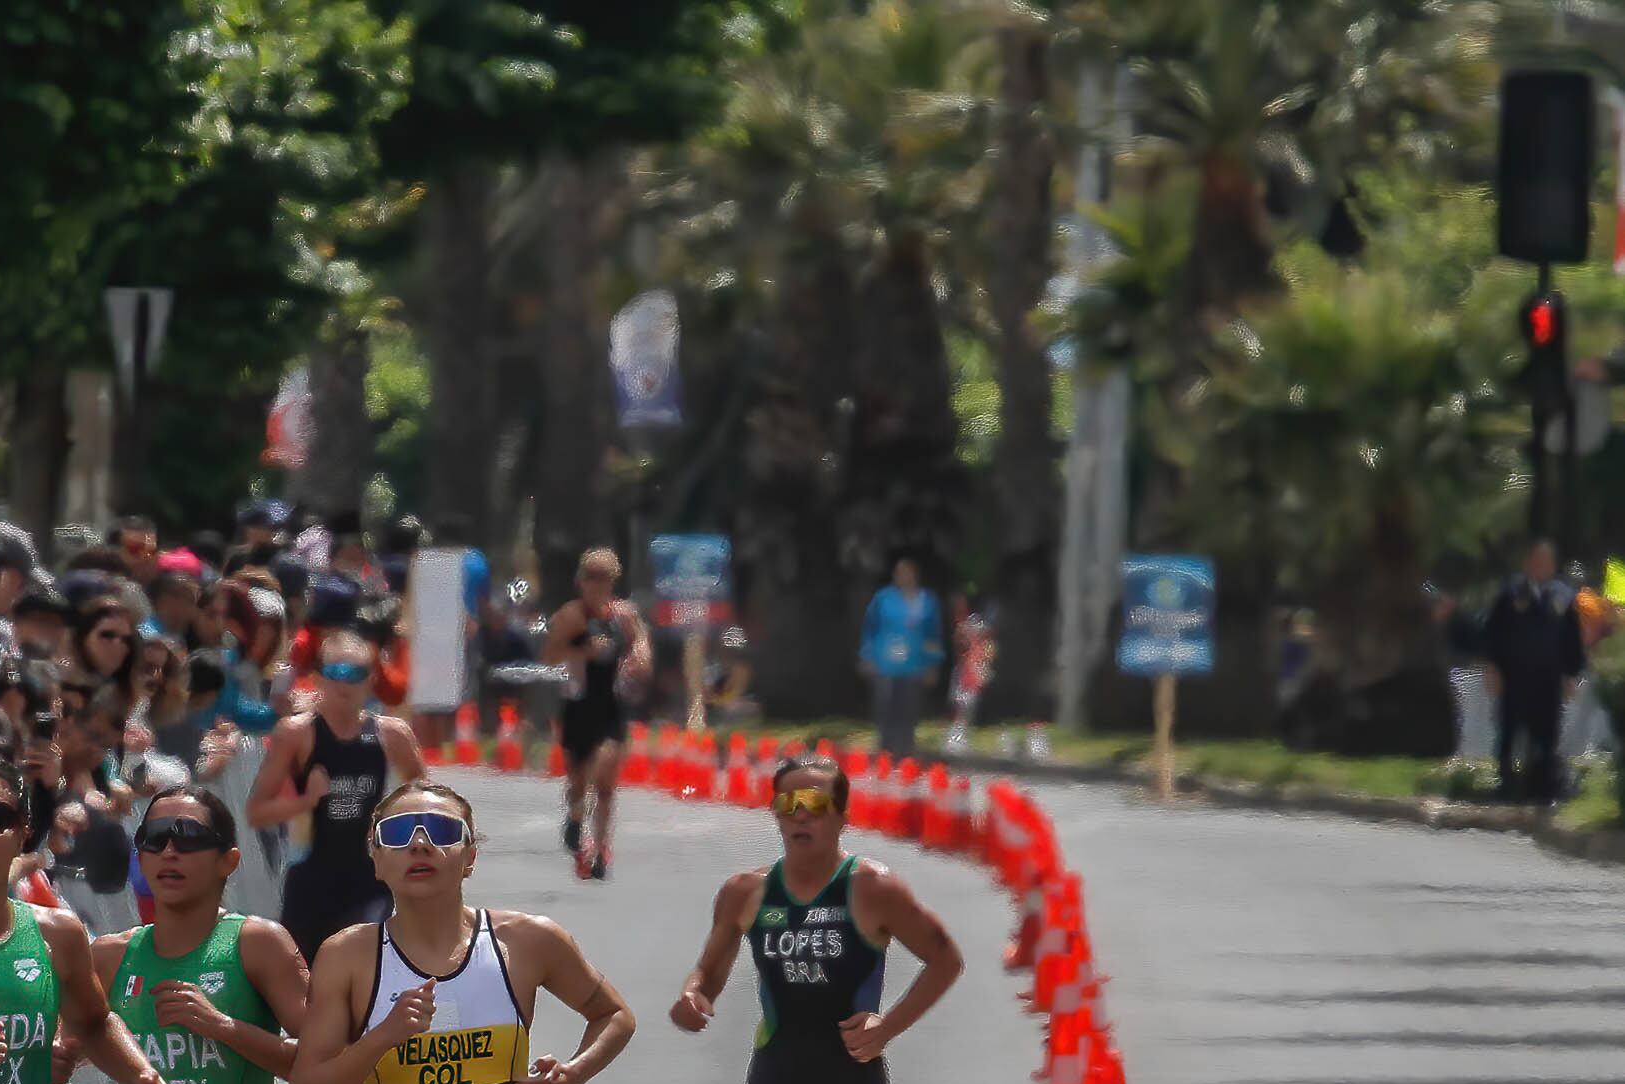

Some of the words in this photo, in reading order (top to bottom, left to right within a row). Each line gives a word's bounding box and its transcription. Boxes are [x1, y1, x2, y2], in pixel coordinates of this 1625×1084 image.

[763, 929, 843, 957] LOPES
[784, 960, 828, 983] BRA
[132, 1033, 226, 1070] APIA
[396, 1029, 494, 1066] VELASQUEZ
